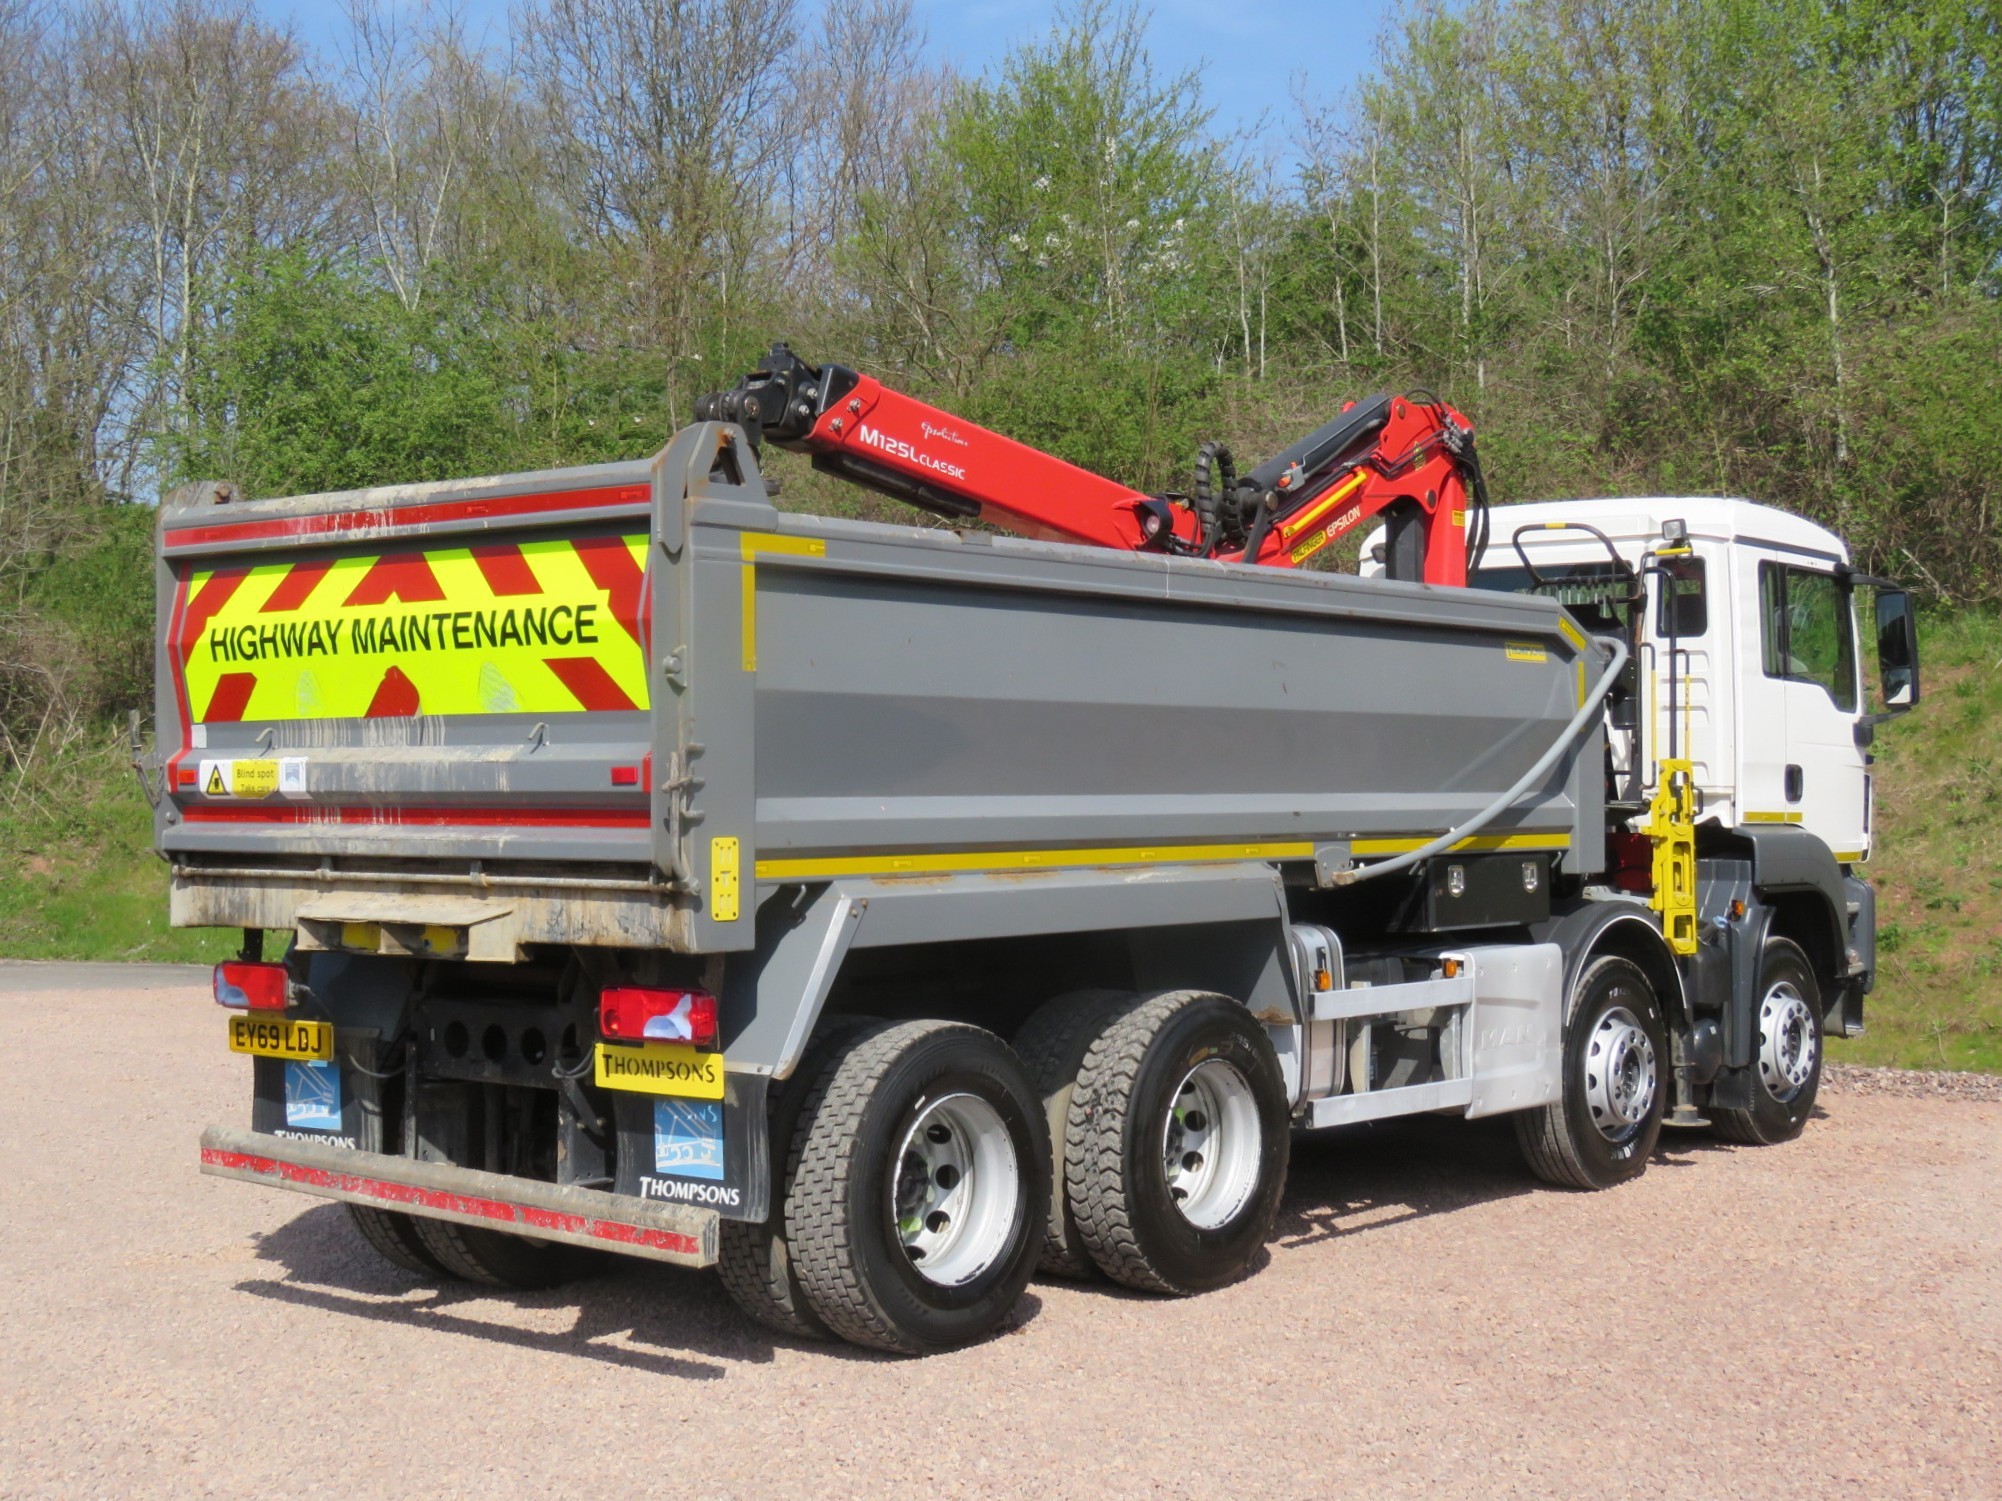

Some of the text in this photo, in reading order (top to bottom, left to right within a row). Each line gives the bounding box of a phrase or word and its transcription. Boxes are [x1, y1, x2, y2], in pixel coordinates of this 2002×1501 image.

[919, 454, 966, 480] CLASSIC
[1326, 505, 1361, 537] EPSILON
[210, 604, 598, 662] HIGHWAY MAINTENANCE
[236, 769, 255, 779] Blind
[257, 769, 275, 780] spot
[241, 784, 271, 794] Take care
[235, 1022, 322, 1054] EY69 LDJ
[602, 1053, 716, 1084] THOMPSONS
[639, 1176, 740, 1206] THOMPSONS
